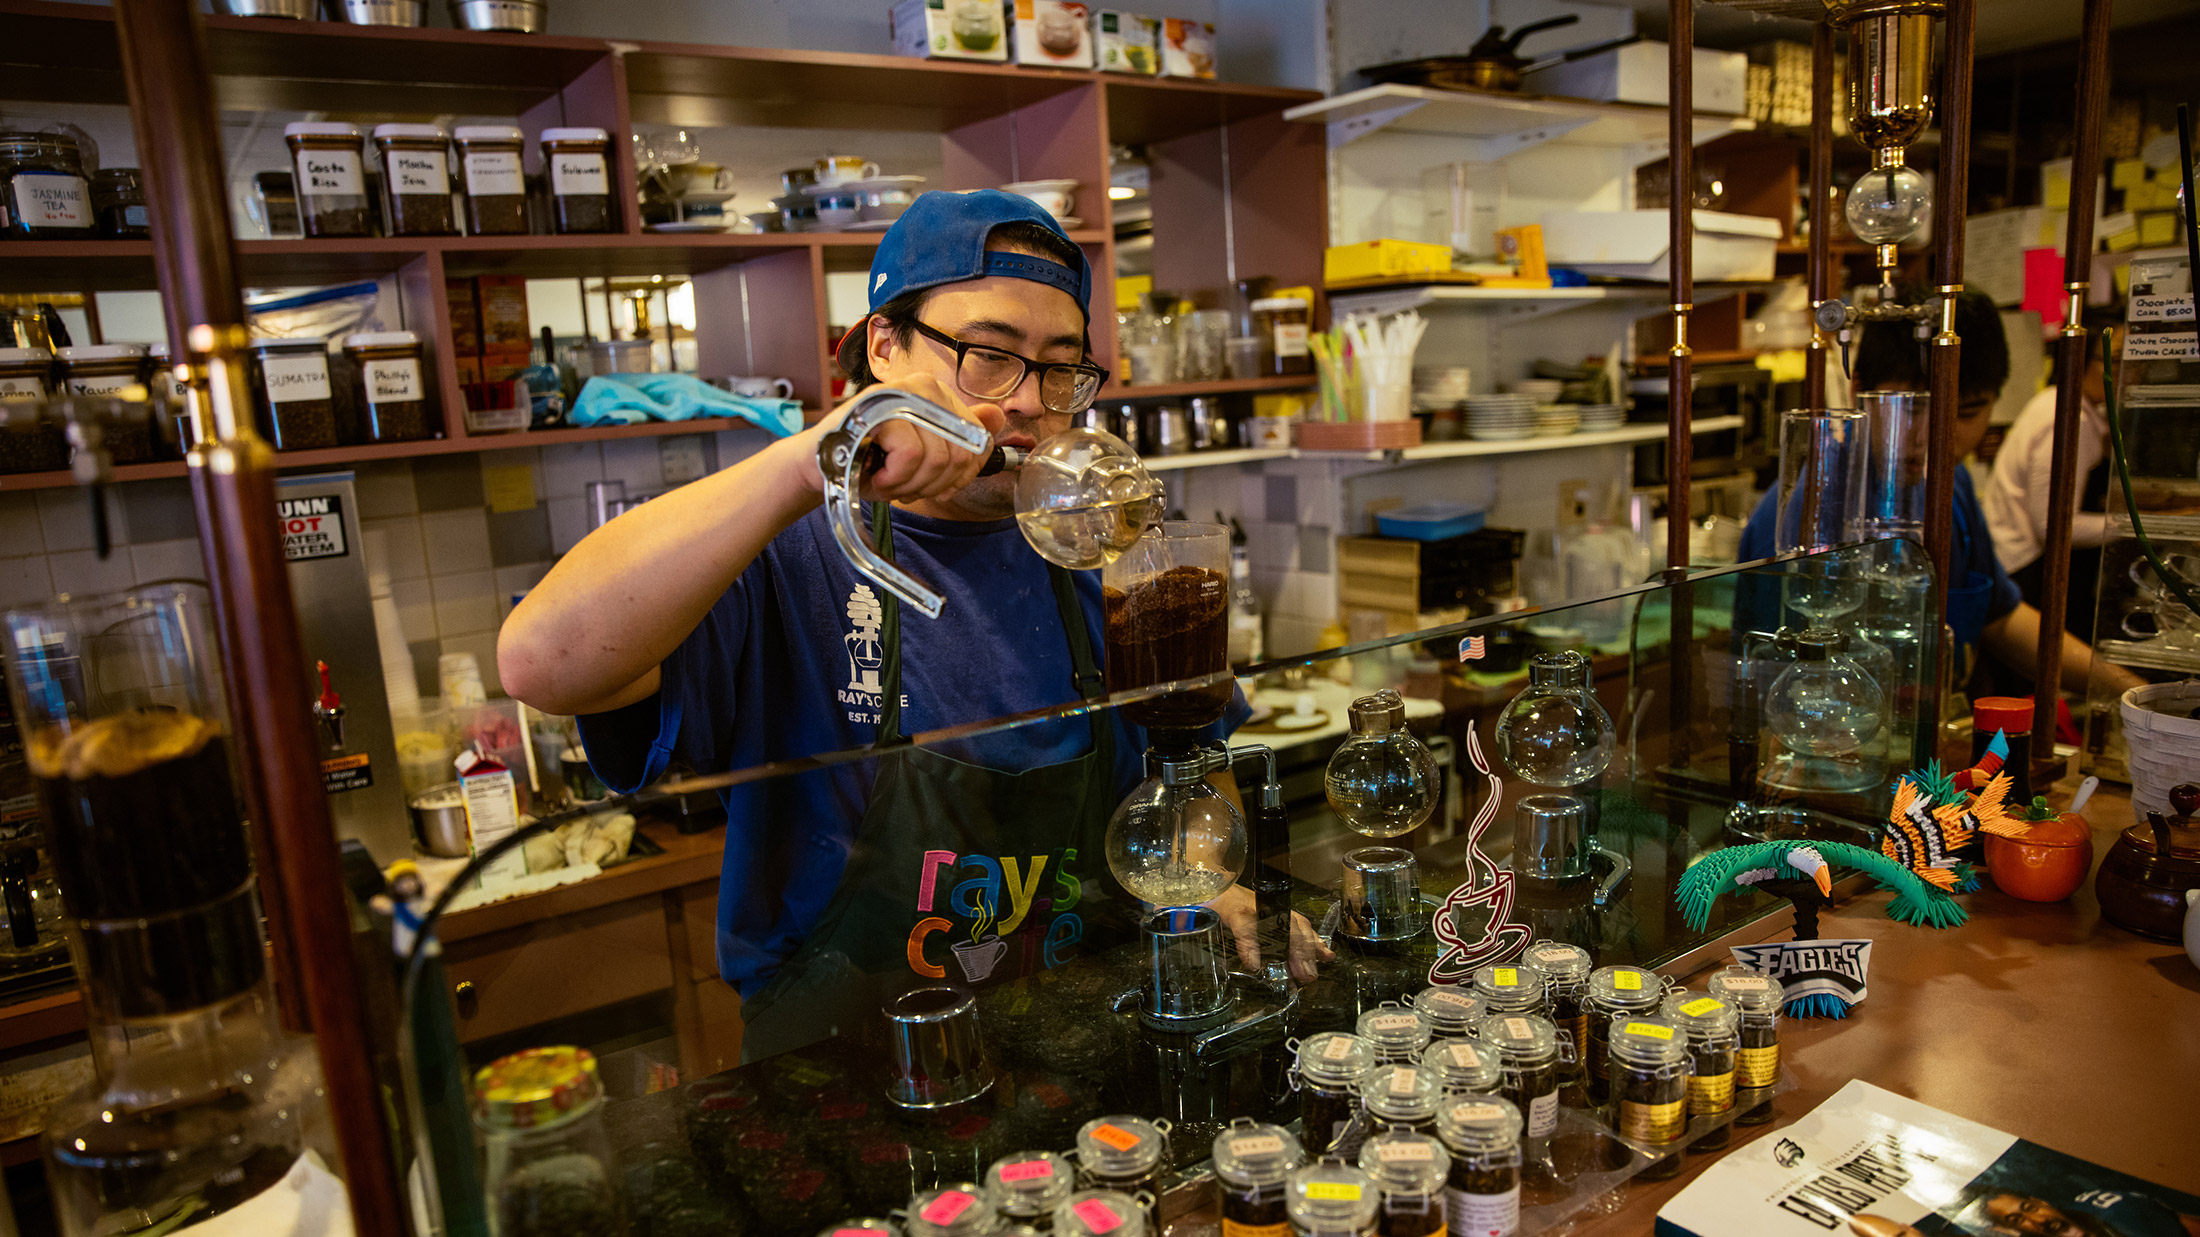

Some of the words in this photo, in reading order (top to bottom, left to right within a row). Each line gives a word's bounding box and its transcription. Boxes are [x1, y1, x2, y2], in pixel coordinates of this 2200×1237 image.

[307, 160, 346, 174] Costa
[311, 177, 339, 188] Rica
[31, 188, 80, 201] JASMINE
[43, 201, 67, 211] TEA
[2136, 297, 2185, 307] Chocolate
[2165, 307, 2193, 317] $5.00
[2128, 337, 2157, 345] White
[2159, 336, 2196, 345] Chocola
[2128, 348, 2159, 356] Truffle
[268, 372, 327, 388] SUMATRA
[0, 390, 36, 398] emen
[376, 386, 409, 396] Blend
[276, 498, 329, 518] UNN
[838, 689, 873, 706] RAY'S
[873, 694, 909, 708] CE
[848, 711, 871, 723] EST.
[1742, 942, 1865, 985] EAGLES
